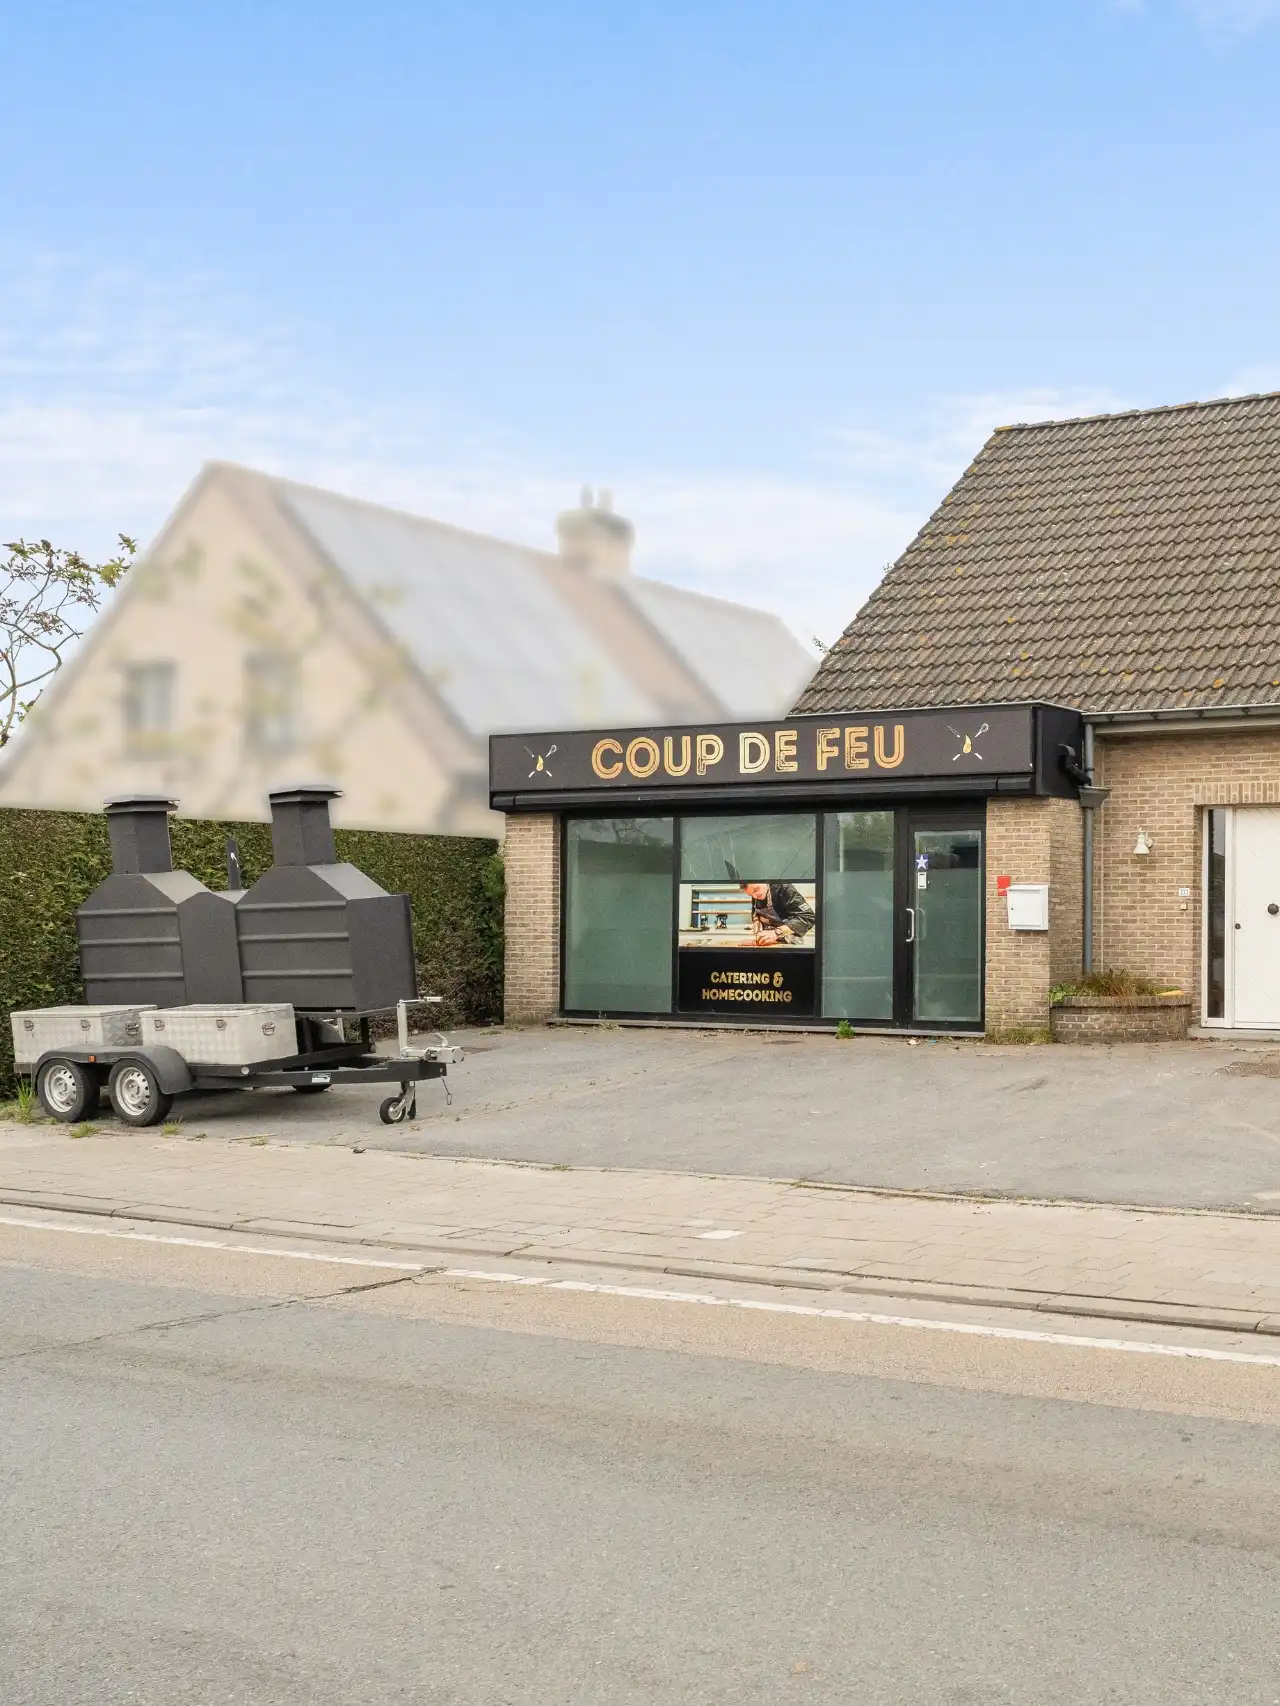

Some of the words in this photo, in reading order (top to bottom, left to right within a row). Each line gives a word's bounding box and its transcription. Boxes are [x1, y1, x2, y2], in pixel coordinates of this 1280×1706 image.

[592, 734, 724, 779] COUP
[739, 730, 798, 773] DE
[816, 725, 904, 771] FEU
[710, 971, 770, 984] CATERING
[773, 971, 784, 988] &
[702, 988, 793, 1002] HOMECOOKING
